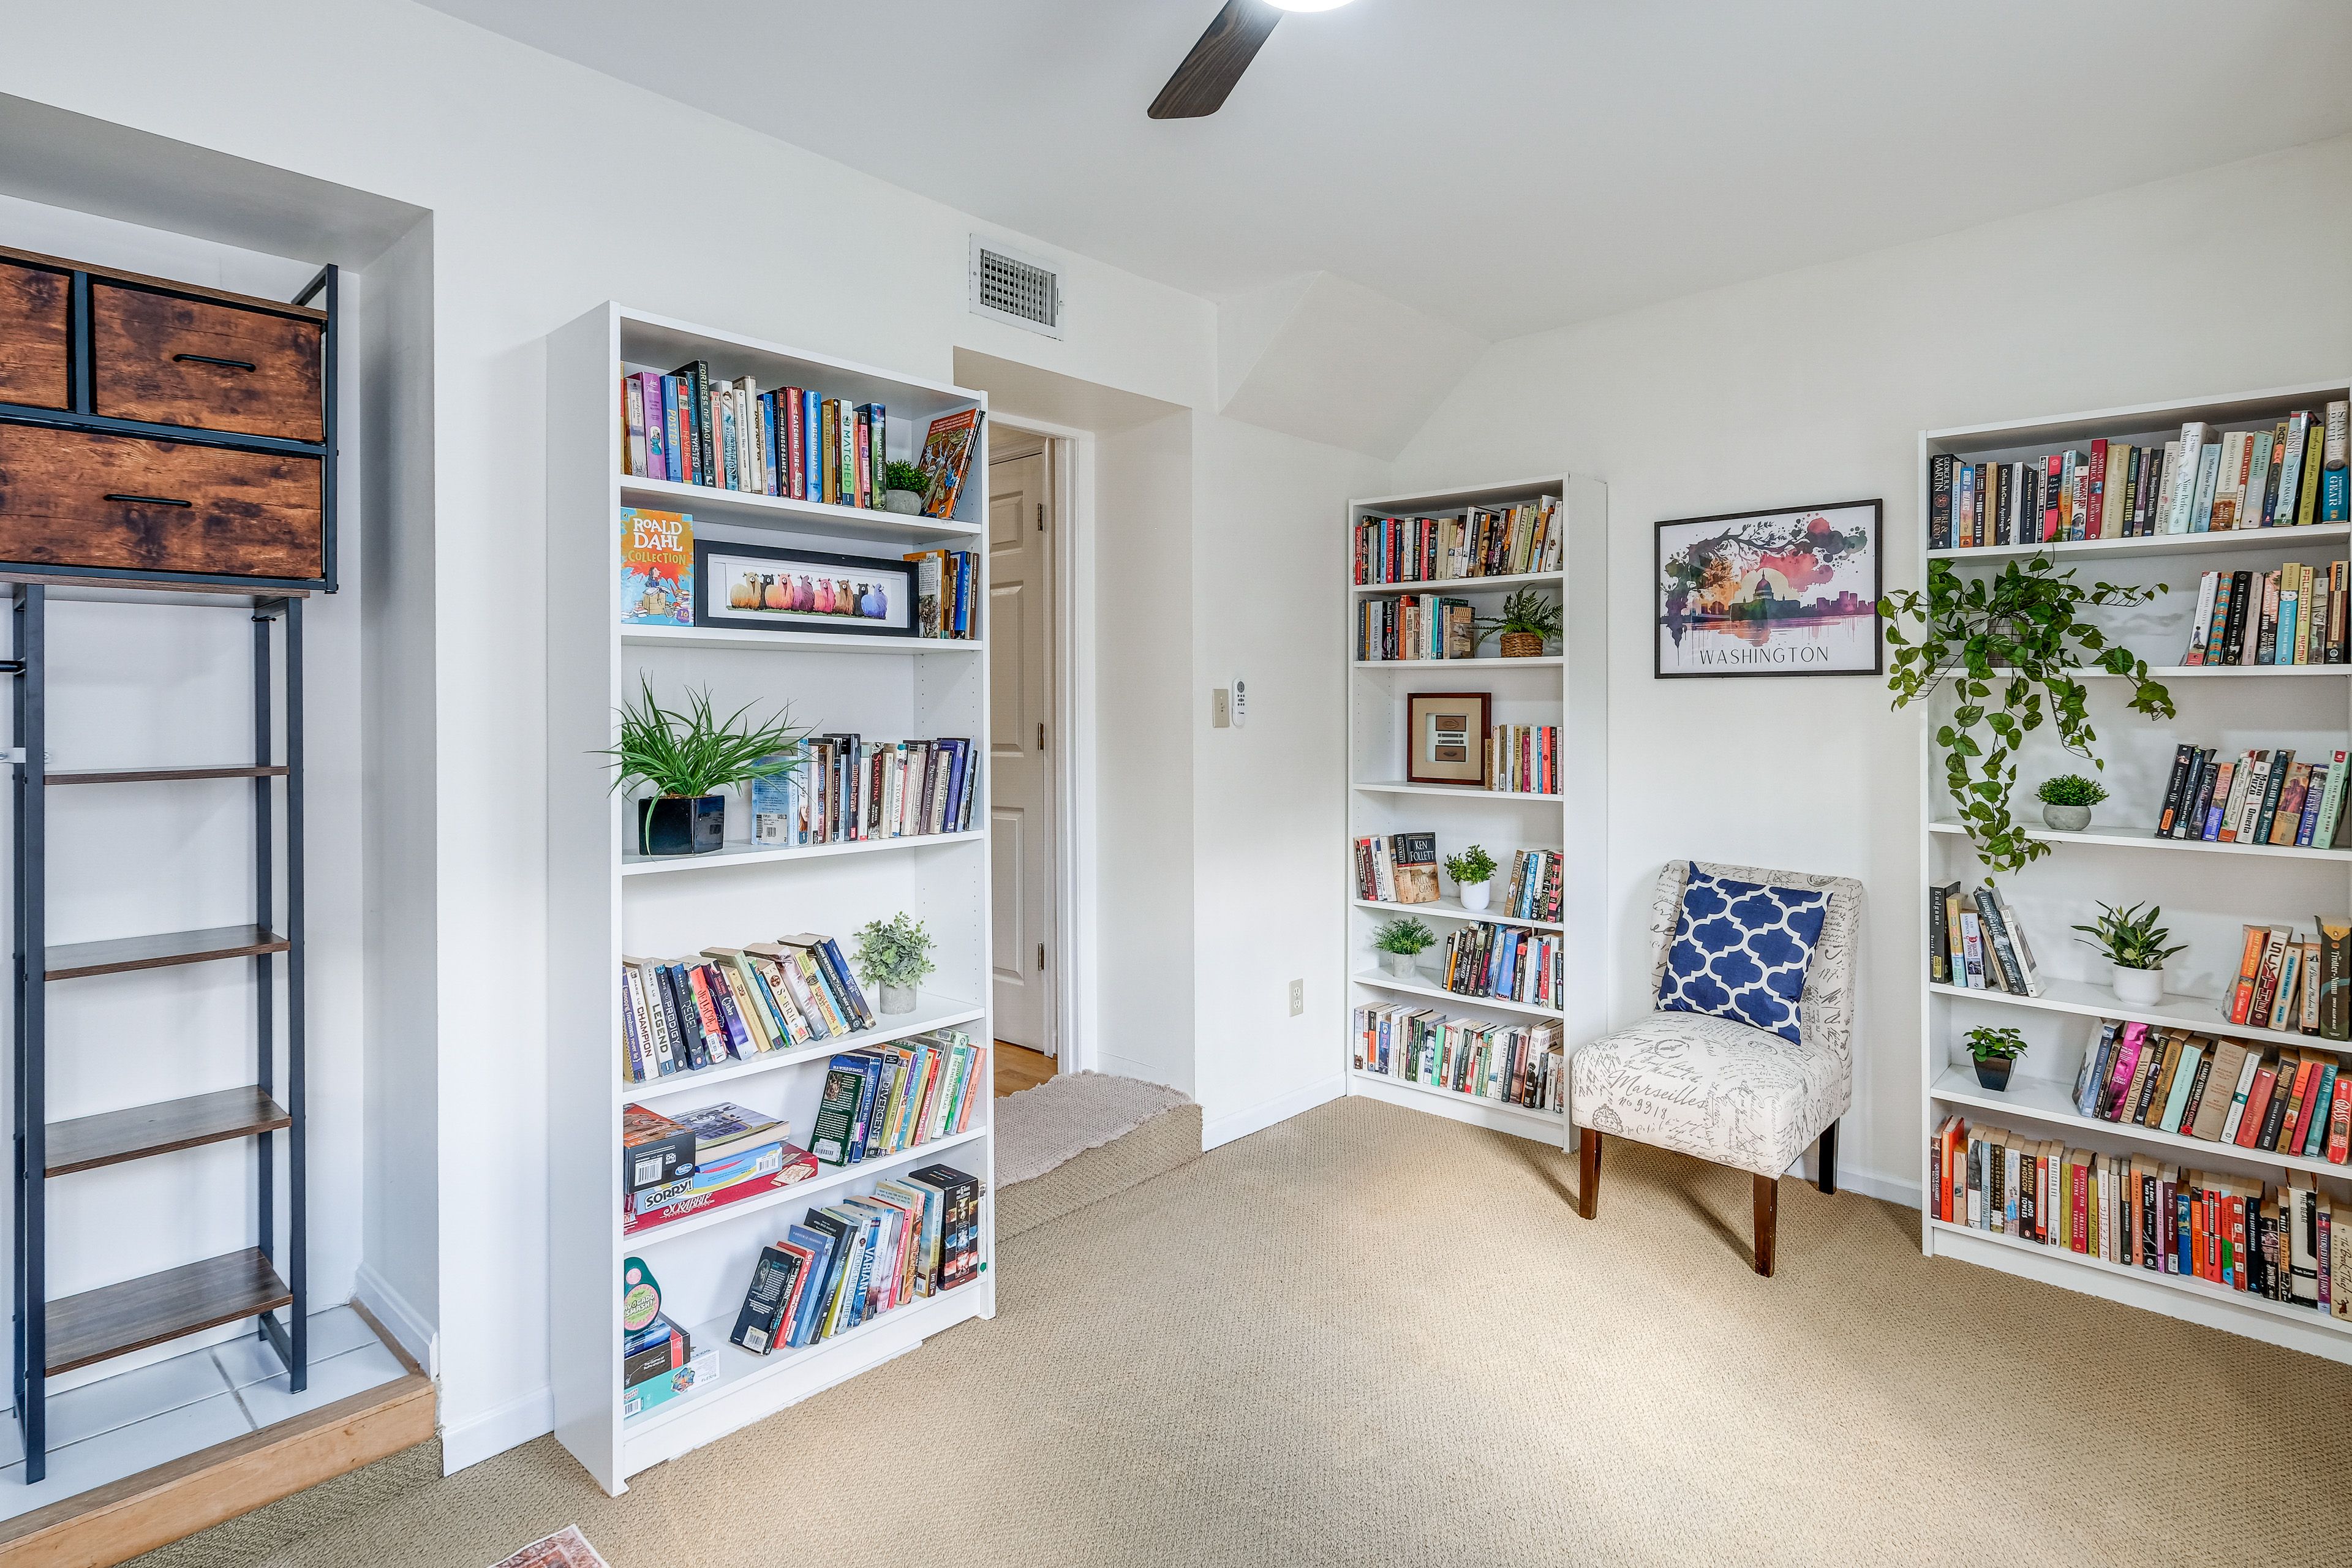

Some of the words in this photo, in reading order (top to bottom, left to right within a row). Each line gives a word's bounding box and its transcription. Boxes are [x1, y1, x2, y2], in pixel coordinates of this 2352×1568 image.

[700, 364, 709, 405] FORTRESS
[704, 409, 709, 418] OF
[668, 409, 677, 446] POSTED
[2337, 411, 2346, 440] STAR
[692, 432, 700, 468] TWISTED
[726, 427, 735, 475] SELECTION
[2227, 439, 2237, 469] FORGOTTEN
[1934, 458, 1943, 492] MARTIN
[2329, 476, 2338, 506] GEAR
[2125, 499, 2134, 521] MATTERS
[2179, 494, 2188, 514] Perfect
[633, 518, 682, 535] ROALD
[1933, 517, 1942, 539] BLOOD
[635, 532, 684, 551] DAHL
[627, 550, 687, 565] COLLECTION
[2299, 569, 2310, 622] PALAHNIUK
[1700, 647, 1828, 665] WASHINGTON
[2297, 635, 2306, 662] PYGMY
[2249, 773, 2260, 795] Puzo
[2256, 774, 2267, 796] Mario
[2305, 789, 2315, 812] REEVE
[1410, 851, 1434, 861] FOLLETT
[1415, 840, 1428, 850] KEN
[1512, 854, 1522, 878] TOBACCO
[1932, 891, 1941, 925] Endgame
[816, 943, 826, 957] JASON
[846, 1006, 855, 1020] DOWN
[665, 1000, 680, 1045] PRODIGY
[681, 1000, 696, 1033] REBEL
[825, 1005, 837, 1023] SCHOOL
[638, 1006, 652, 1057] CHAMPION
[653, 1004, 668, 1053] LEGEND
[911, 1064, 921, 1087] Capture
[946, 1068, 955, 1091] EMERALD
[2131, 1060, 2148, 1092] WALDEN
[2198, 1068, 2208, 1081] MARY
[2326, 1068, 2334, 1079] AMY
[866, 1076, 875, 1096] UNDER
[1608, 1070, 1708, 1111] Marseilles
[2193, 1082, 2204, 1101] STEWART
[2323, 1081, 2331, 1093] TAN
[872, 1081, 891, 1141] DIVERGENT
[906, 1096, 916, 1115] Castle
[922, 1091, 932, 1114] MANIAC
[2125, 1095, 2138, 1112] TWO
[2333, 1099, 2350, 1121] GRASS
[918, 1115, 926, 1134] MAGEE
[647, 1180, 692, 1207] SORRY!
[663, 1193, 712, 1216] SCRABBLE
[832, 1256, 845, 1289] NAVIGATING
[852, 1249, 864, 1274] PIECING
[858, 1246, 875, 1297] VARIANT
[784, 1274, 795, 1299] TOLKIEN
[851, 1275, 857, 1285] ME
[625, 1301, 654, 1316] SMASH!
[843, 1285, 856, 1319] TOGETHER
